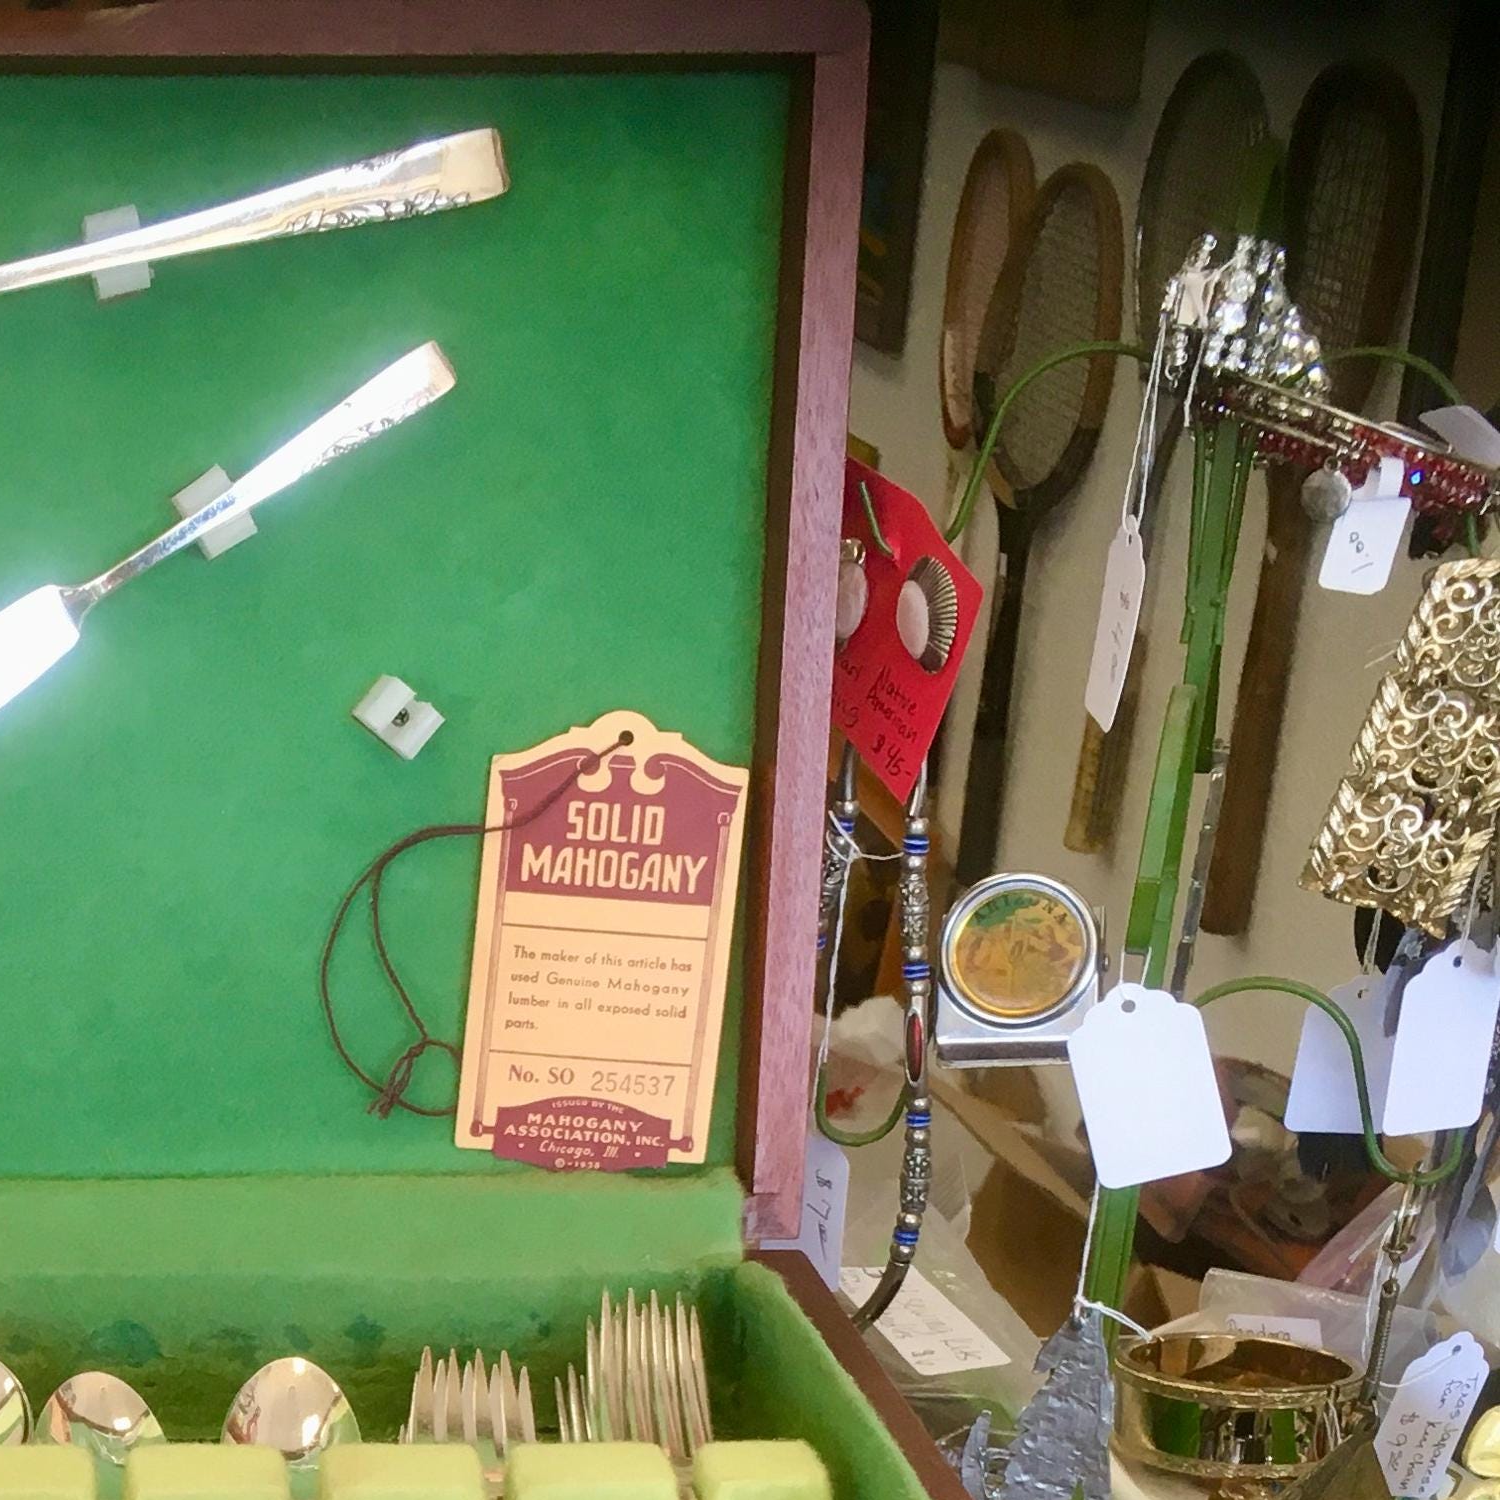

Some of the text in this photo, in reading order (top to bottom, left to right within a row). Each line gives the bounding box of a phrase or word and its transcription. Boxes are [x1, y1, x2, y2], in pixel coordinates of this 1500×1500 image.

[565, 800, 666, 845] SOLID
[520, 843, 709, 894] MAHOGANY
[513, 945, 692, 972] The maker of this article has
[510, 971, 690, 997] used Genuine Mahogany
[507, 991, 687, 1019] lumber in all exposed solid
[504, 1018, 539, 1031] parts.
[508, 1064, 676, 1097] No. SO 254537
[552, 1099, 588, 1108] ISSUED
[607, 1103, 626, 1114] THE
[503, 1124, 665, 1147] ASSOCIATION, INC.
[526, 1113, 644, 1133] MAHOGANY
[538, 1140, 595, 1158] Chicago,
[1450, 1372, 1480, 1420] Texas
